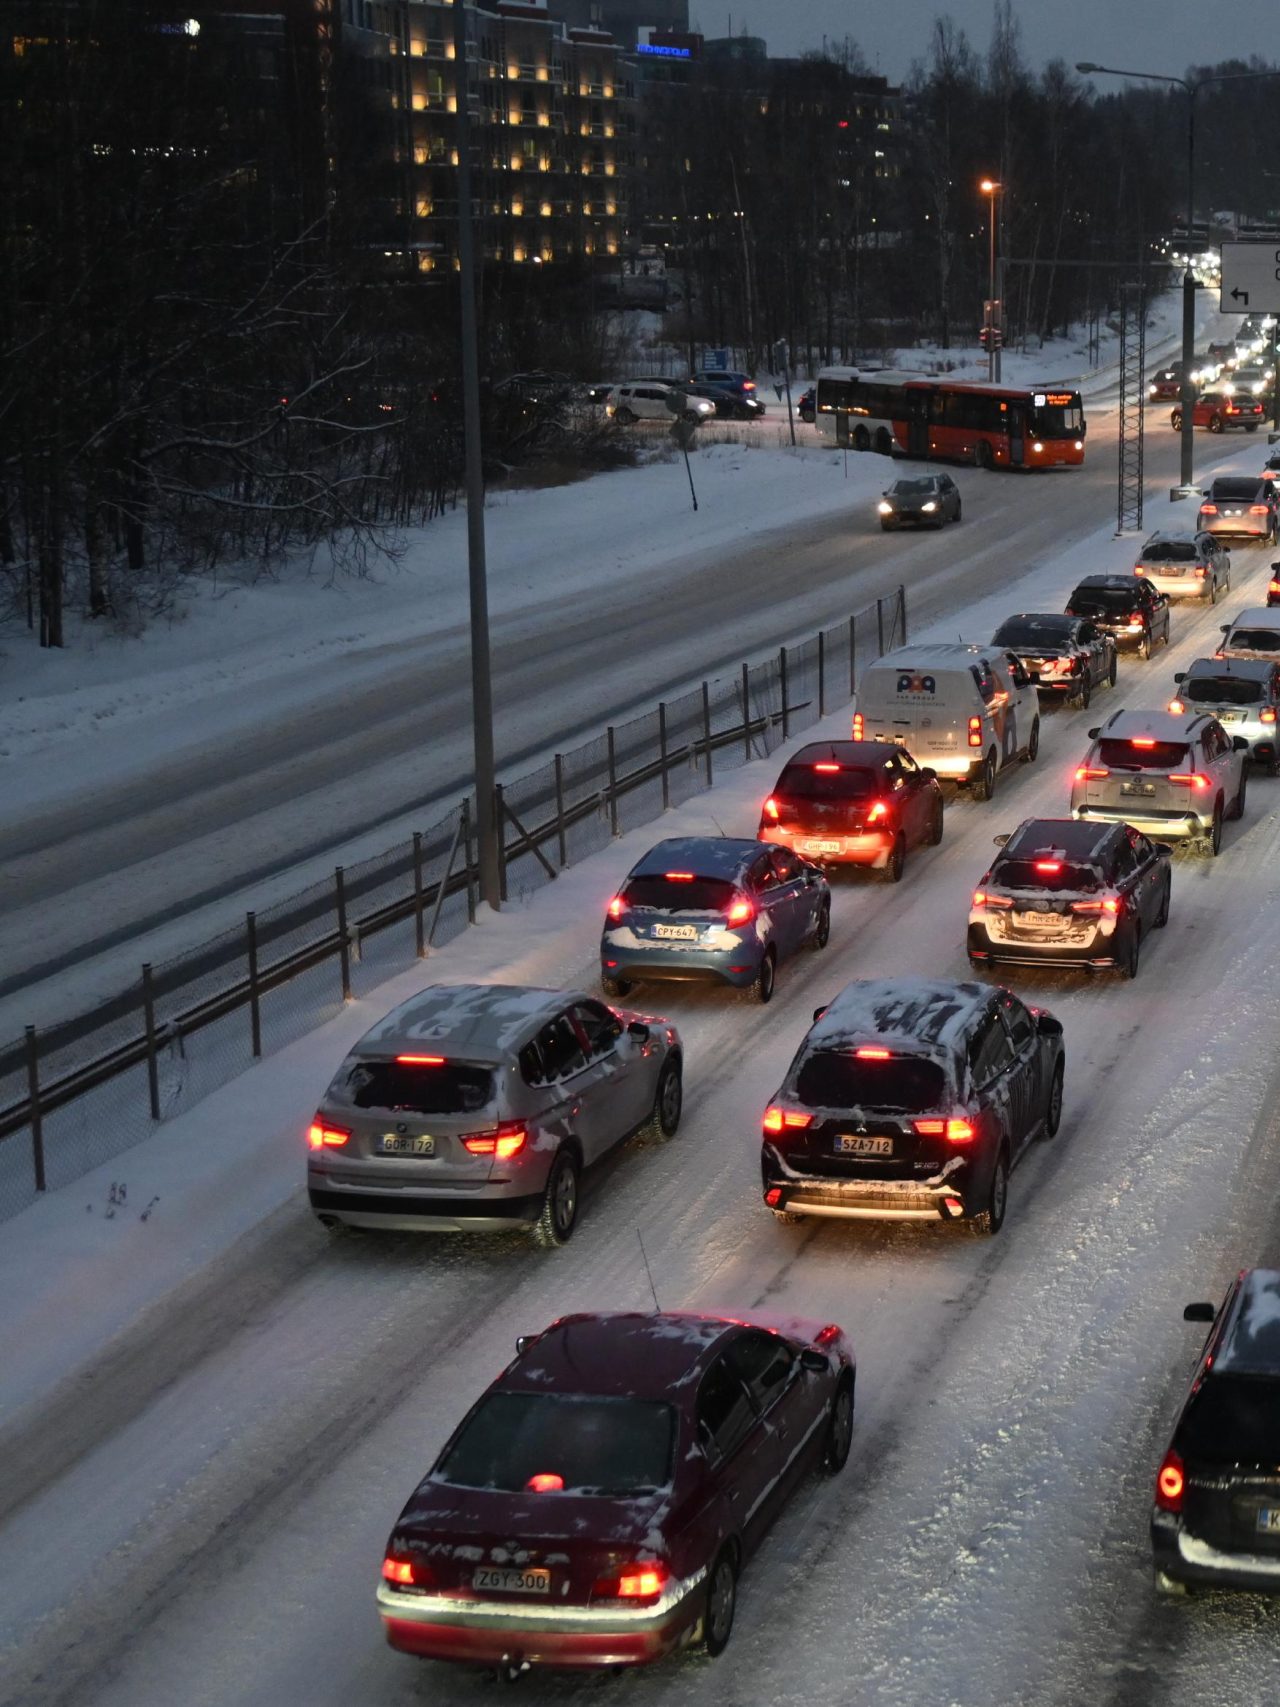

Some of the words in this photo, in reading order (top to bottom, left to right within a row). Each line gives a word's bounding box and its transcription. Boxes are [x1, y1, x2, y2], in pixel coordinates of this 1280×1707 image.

[657, 927, 693, 938] CPY-647
[385, 1138, 433, 1153] GOR-172
[843, 1139, 890, 1153] SZA-712
[479, 1570, 547, 1590] ZGY-300
